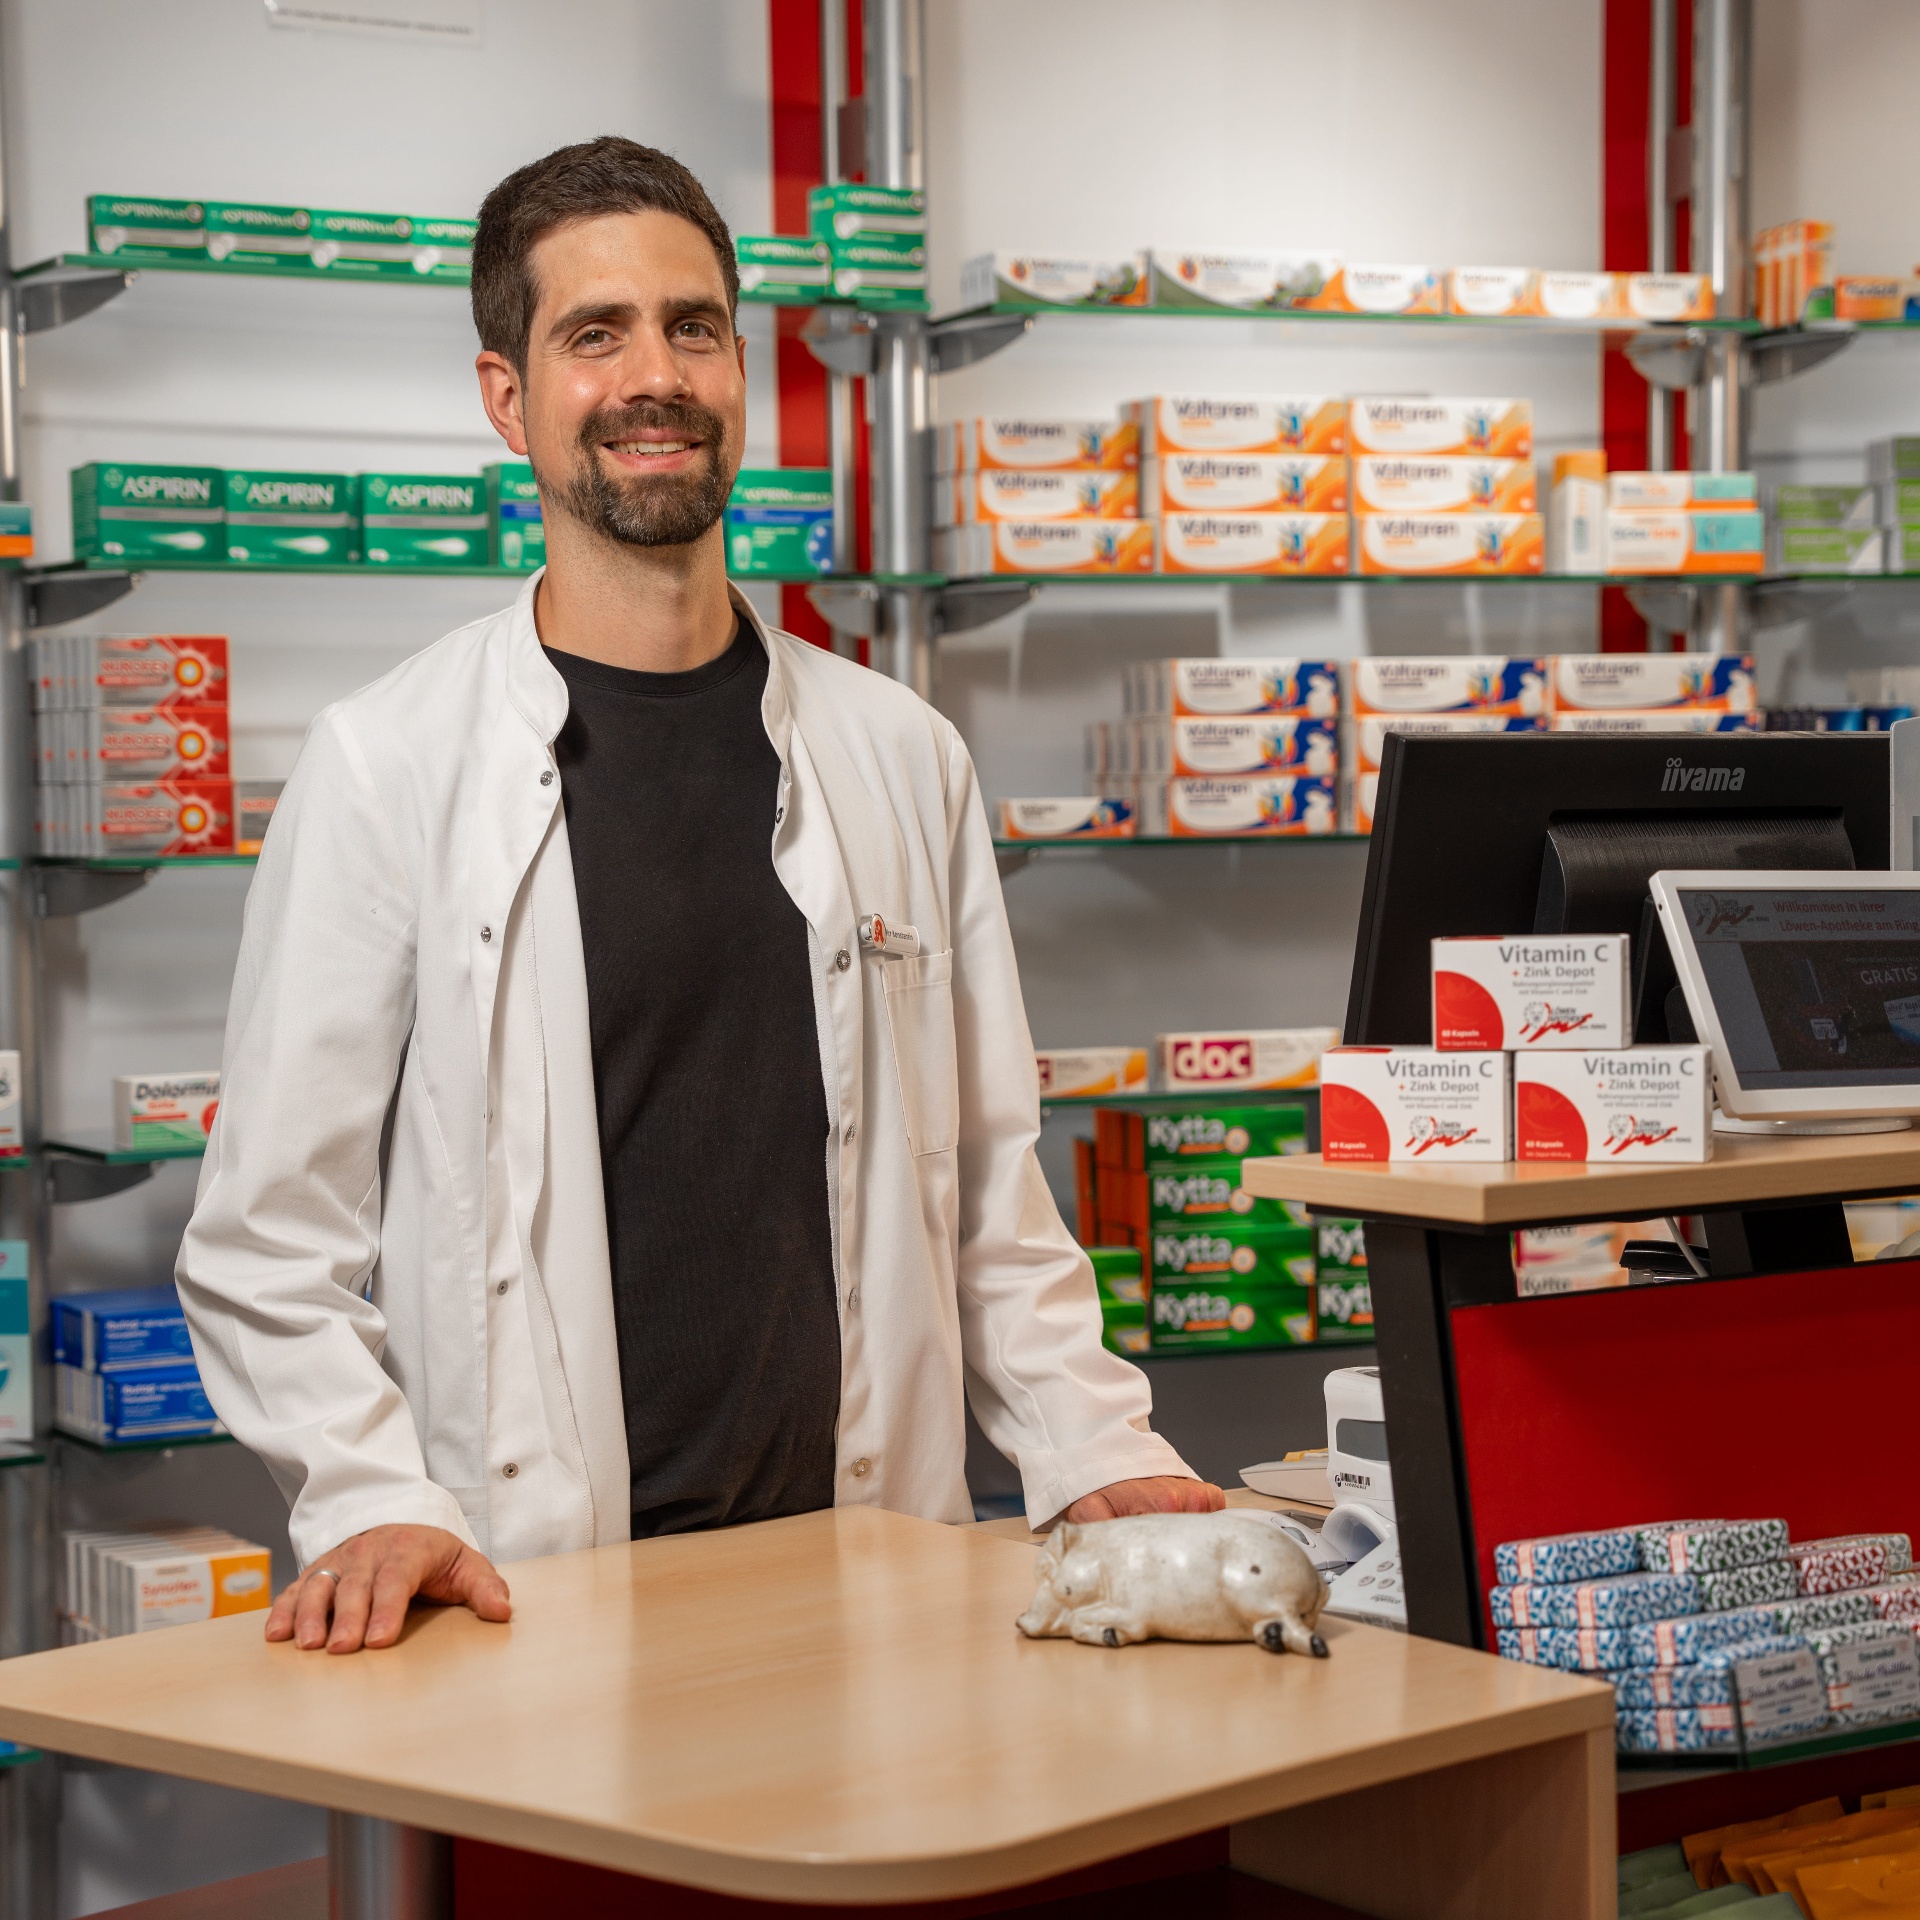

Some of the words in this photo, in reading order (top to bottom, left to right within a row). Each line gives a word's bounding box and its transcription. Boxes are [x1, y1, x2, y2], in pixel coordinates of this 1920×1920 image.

[122, 475, 211, 501] ASPIRIN
[246, 481, 335, 506] ASPIRIN
[386, 484, 475, 508] ASPIRIN
[102, 659, 171, 674] NUROFEN
[103, 733, 173, 748] NUROFEN
[1661, 757, 1746, 792] iiyama
[106, 807, 175, 822] NUROFEN
[1773, 901, 1844, 913] Willkommen
[1847, 901, 1857, 912] in
[1859, 901, 1886, 912] Ihrer
[1779, 920, 1873, 933] Löwen-Apotheke
[1876, 922, 1892, 931] am
[1499, 943, 1586, 964] Vitamin
[1594, 944, 1609, 963] C
[1523, 966, 1552, 978] Zink
[1555, 966, 1595, 980] Depot
[1176, 1039, 1250, 1079] doc
[1385, 1059, 1471, 1078] Vitamin
[1479, 1059, 1493, 1078] C
[1583, 1056, 1671, 1075] Vitamin
[1679, 1057, 1694, 1076] C
[1409, 1080, 1437, 1092] Zink
[1440, 1081, 1480, 1094] Depot
[1608, 1079, 1636, 1090] Zink
[1640, 1079, 1681, 1092] Depot
[1148, 1114, 1226, 1154] Kytta
[1153, 1173, 1231, 1214] Kytta
[1154, 1232, 1232, 1273] Kytta
[1153, 1291, 1231, 1331] Kytta
